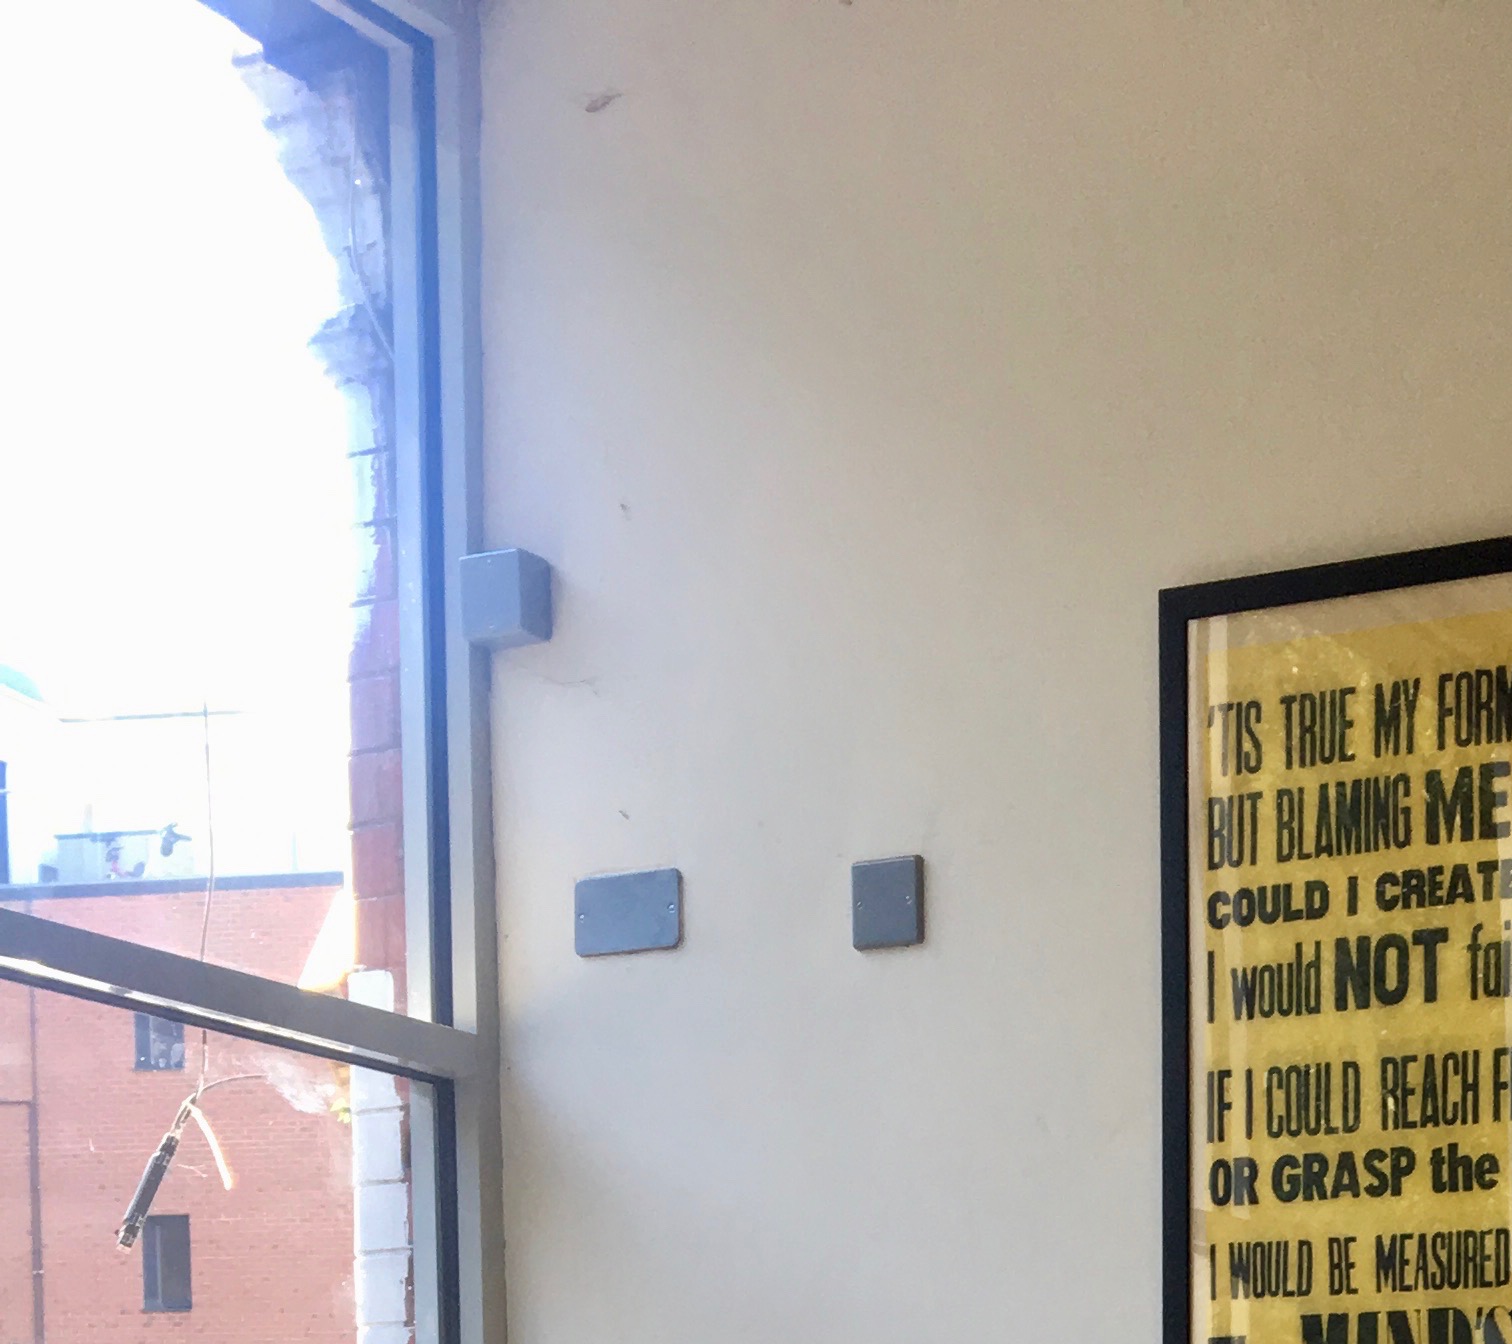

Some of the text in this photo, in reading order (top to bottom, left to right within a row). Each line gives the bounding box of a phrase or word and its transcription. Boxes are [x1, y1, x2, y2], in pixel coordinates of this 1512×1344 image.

[1280, 687, 1356, 770] TRUE
[1374, 678, 1421, 758] MY
[1207, 790, 1259, 870] BUT
[1276, 774, 1413, 863] BLAMING
[1425, 761, 1512, 846] ME
[1207, 879, 1330, 929] COULD
[1348, 876, 1357, 916] I
[1206, 951, 1215, 1023] I
[1231, 941, 1322, 1020] would
[1333, 927, 1449, 1011] NOT
[1206, 1068, 1232, 1143] IF
[1246, 1068, 1253, 1139] I
[1266, 1063, 1361, 1137] COULD
[1380, 1048, 1480, 1131] REACH
[1208, 1153, 1259, 1207] OR
[1271, 1145, 1416, 1202] GRASP
[1430, 1144, 1498, 1193] the
[1209, 1244, 1216, 1301] I
[1229, 1238, 1313, 1299] WOULD
[1329, 1237, 1357, 1295] BE
[1374, 1226, 1510, 1292] MEASURED
